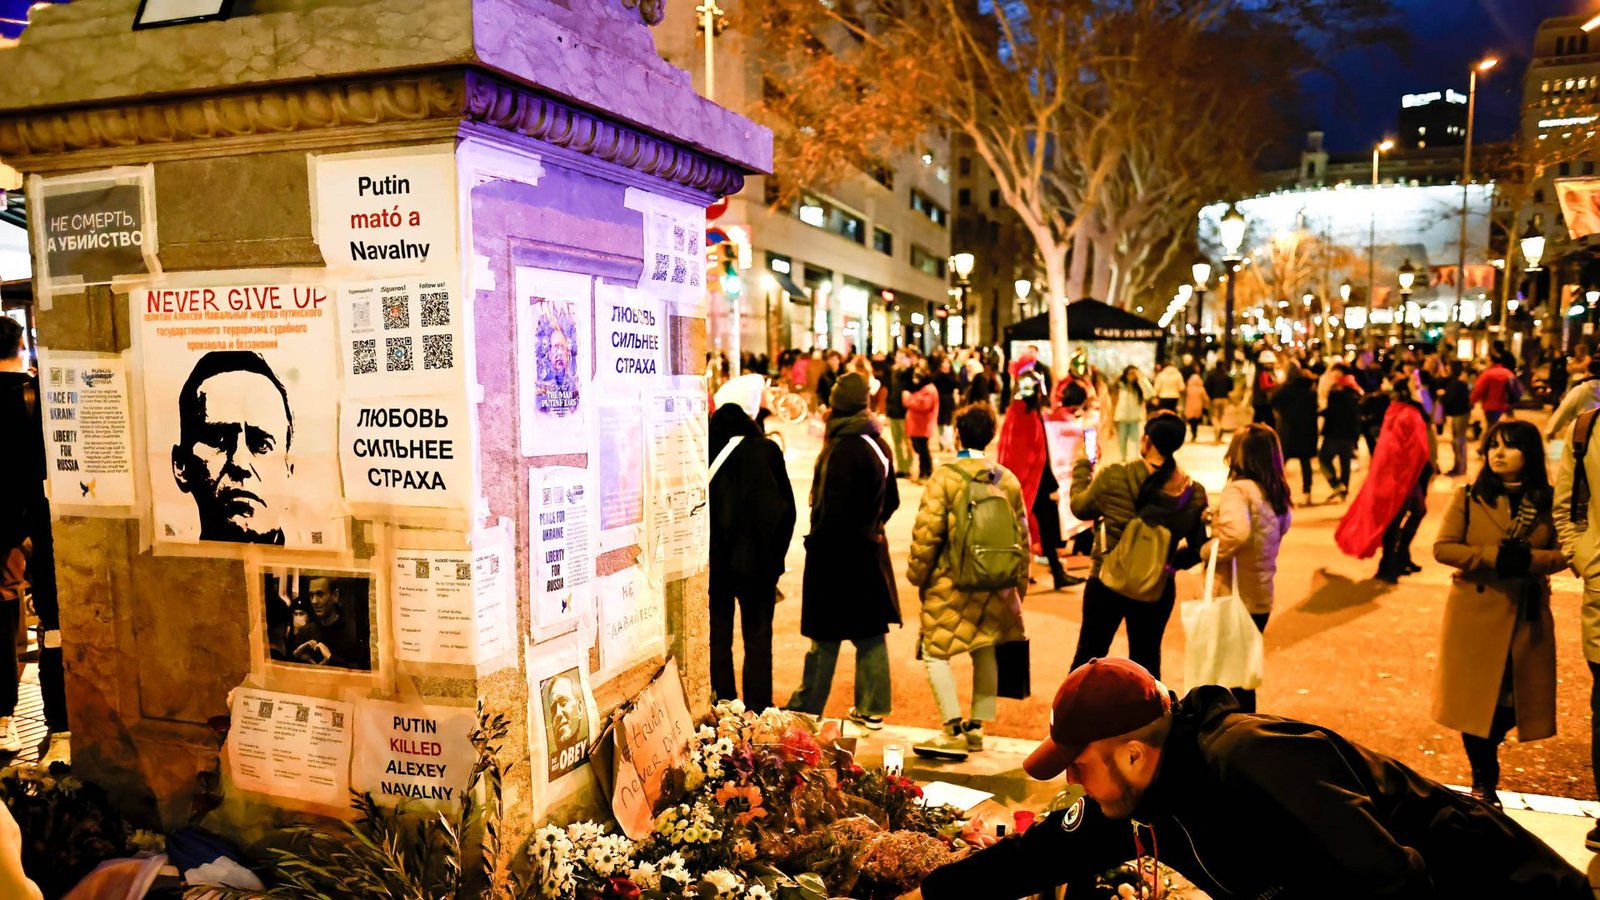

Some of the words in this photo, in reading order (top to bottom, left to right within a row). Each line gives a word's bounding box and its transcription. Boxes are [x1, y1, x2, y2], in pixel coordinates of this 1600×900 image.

[358, 174, 410, 197] Putin
[51, 216, 69, 232] НЕ
[71, 210, 136, 230] СМЕРТЬ,
[350, 205, 402, 229] mató
[409, 210, 420, 227] a
[47, 237, 57, 252] А
[58, 230, 142, 251] УБИЙСТВО
[350, 239, 430, 263] Navalny
[147, 288, 220, 313] NEVER
[227, 286, 282, 311] GIVE
[292, 286, 327, 309] UP
[611, 331, 659, 351] СИЛЬНЕЕ
[615, 357, 657, 375] СТРАХА
[356, 407, 448, 428] ЛЮБОВЬ
[53, 430, 78, 443] LIBERTY
[353, 438, 454, 460] СИЛЬНЕЕ
[56, 458, 80, 471] RUSSIA
[367, 468, 447, 490] СТРАХА
[542, 526, 564, 542] UKRAINE
[545, 548, 565, 564] LIBERTY
[551, 564, 561, 578] FOR
[546, 577, 564, 592] RUSSIA
[393, 716, 437, 734] PUTIN
[389, 737, 442, 757] KILLED
[559, 738, 588, 770] OBEY
[385, 759, 447, 779] ALEXEY
[380, 781, 454, 801] NAVALNY
